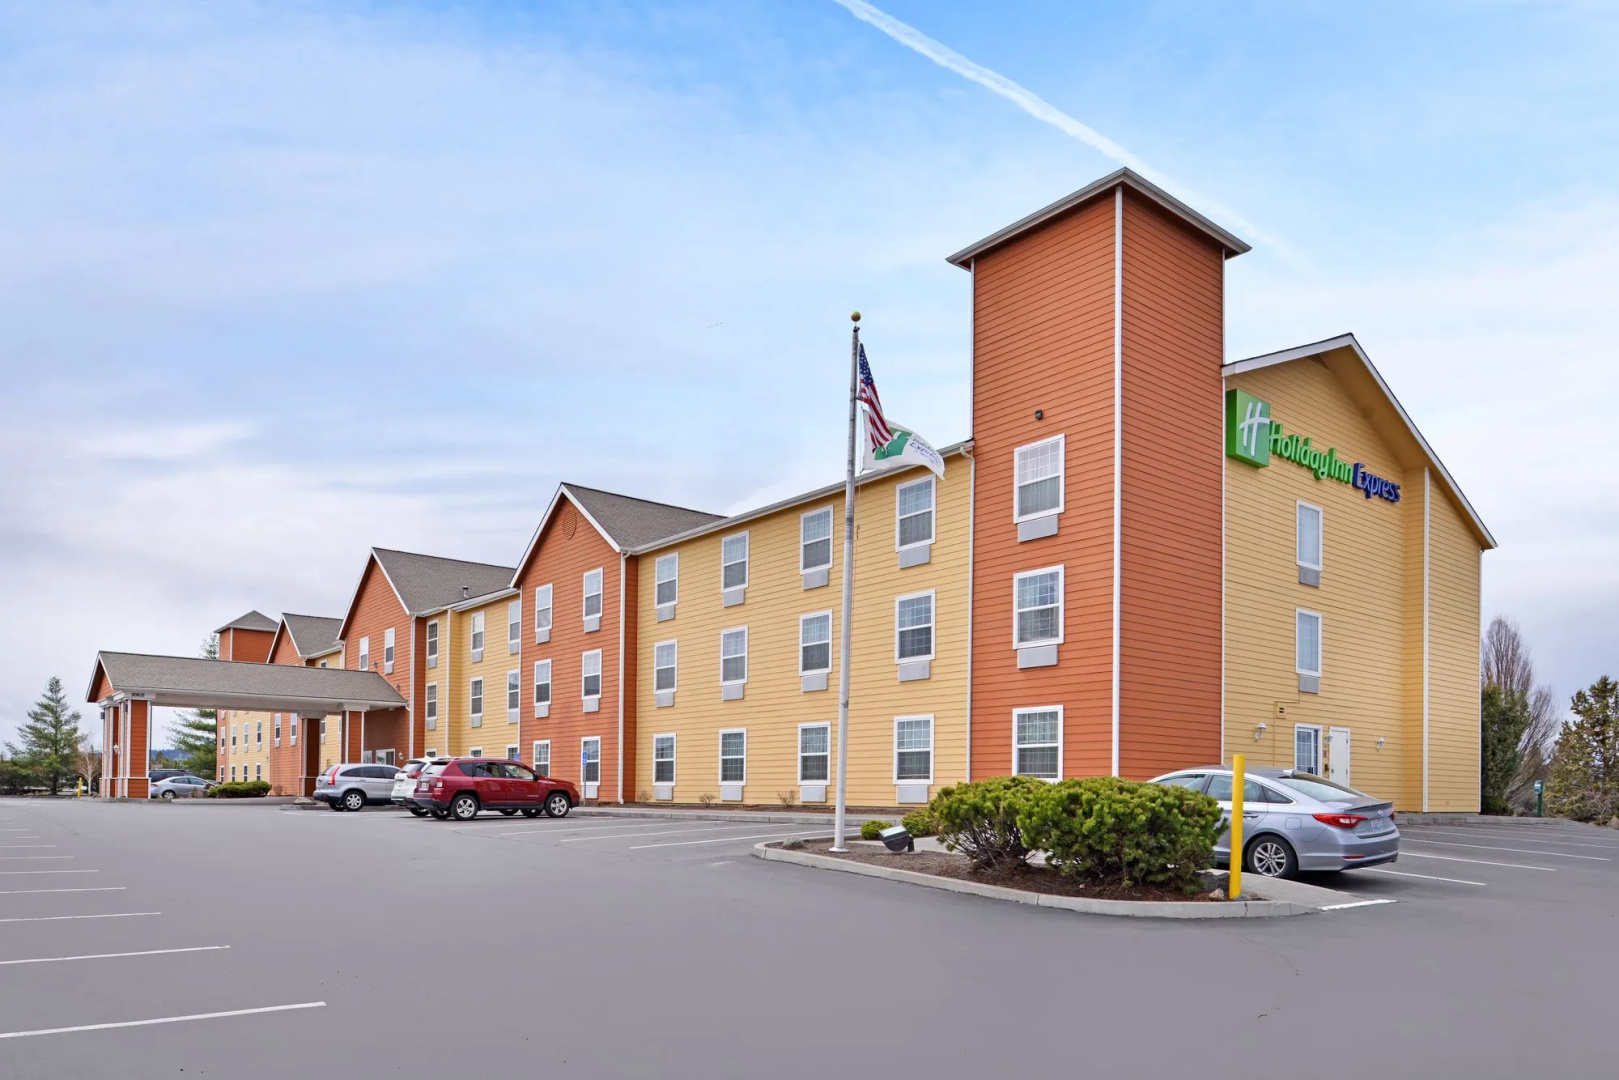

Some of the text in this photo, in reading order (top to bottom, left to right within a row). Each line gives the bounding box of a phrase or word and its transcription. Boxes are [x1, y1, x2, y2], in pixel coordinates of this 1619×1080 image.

[1269, 420, 1401, 502] Holiday Inn Express
